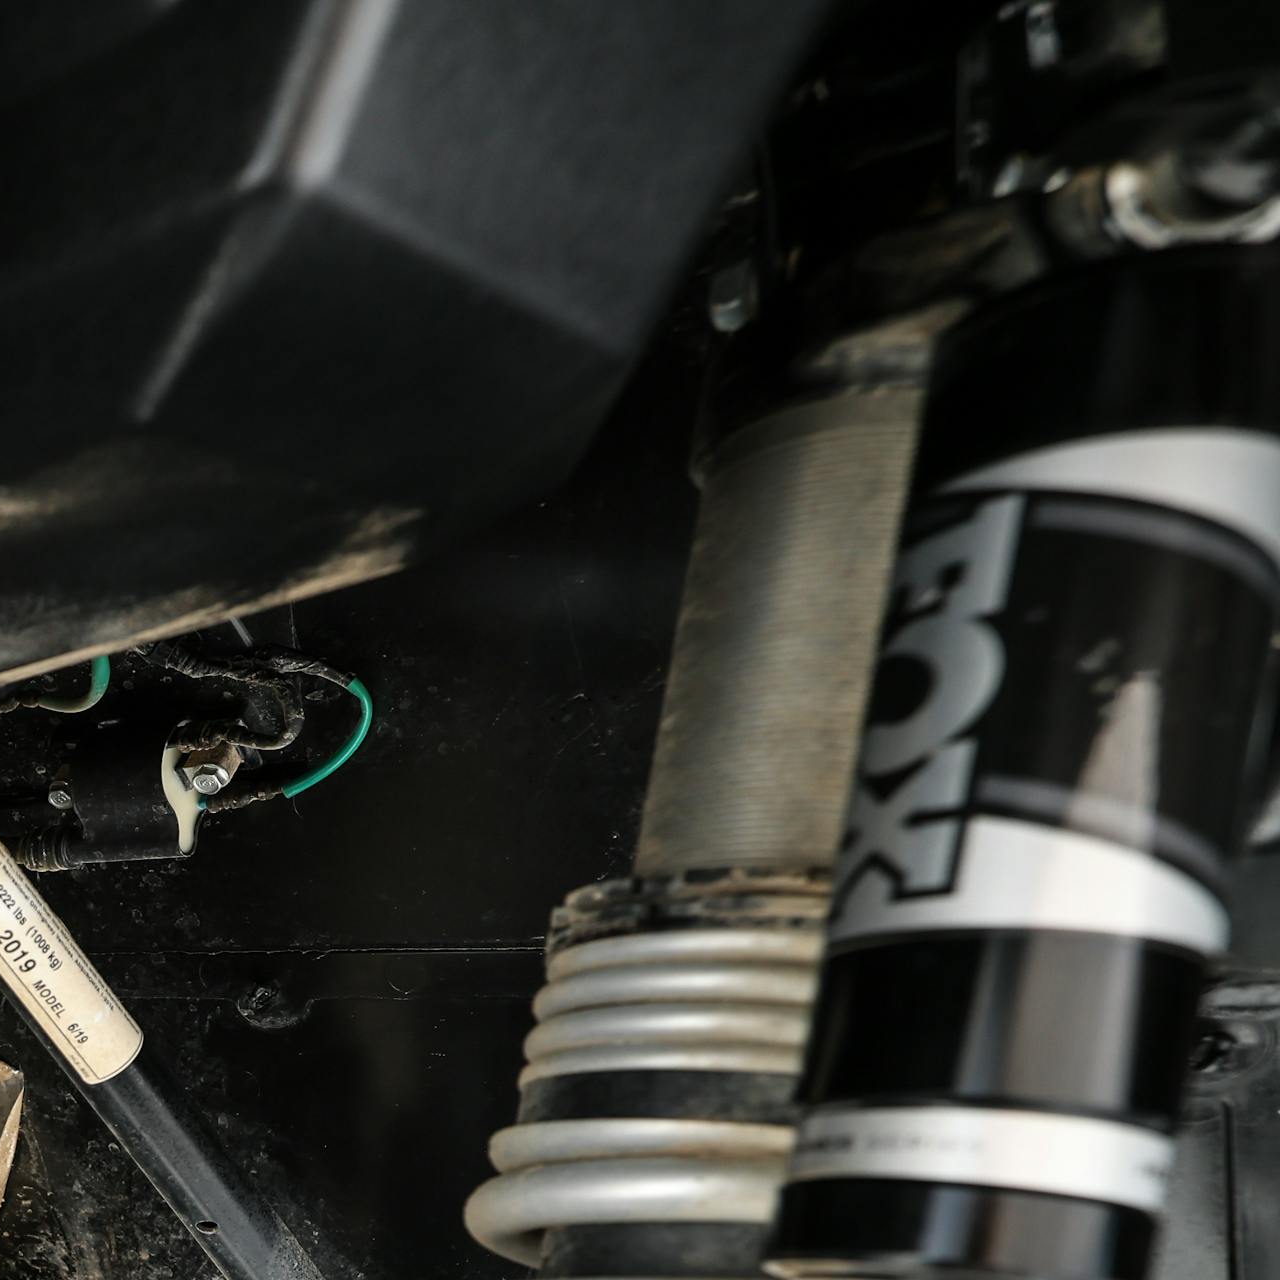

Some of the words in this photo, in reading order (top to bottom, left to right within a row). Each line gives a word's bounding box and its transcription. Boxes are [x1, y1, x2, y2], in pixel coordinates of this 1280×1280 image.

[834, 493, 1027, 903] FOX
[12, 907, 27, 925] lbs
[25, 925, 51, 954] (1008
[47, 951, 63, 971] kg)
[32, 979, 66, 1019] MODEL
[67, 1023, 89, 1044] 6/19
